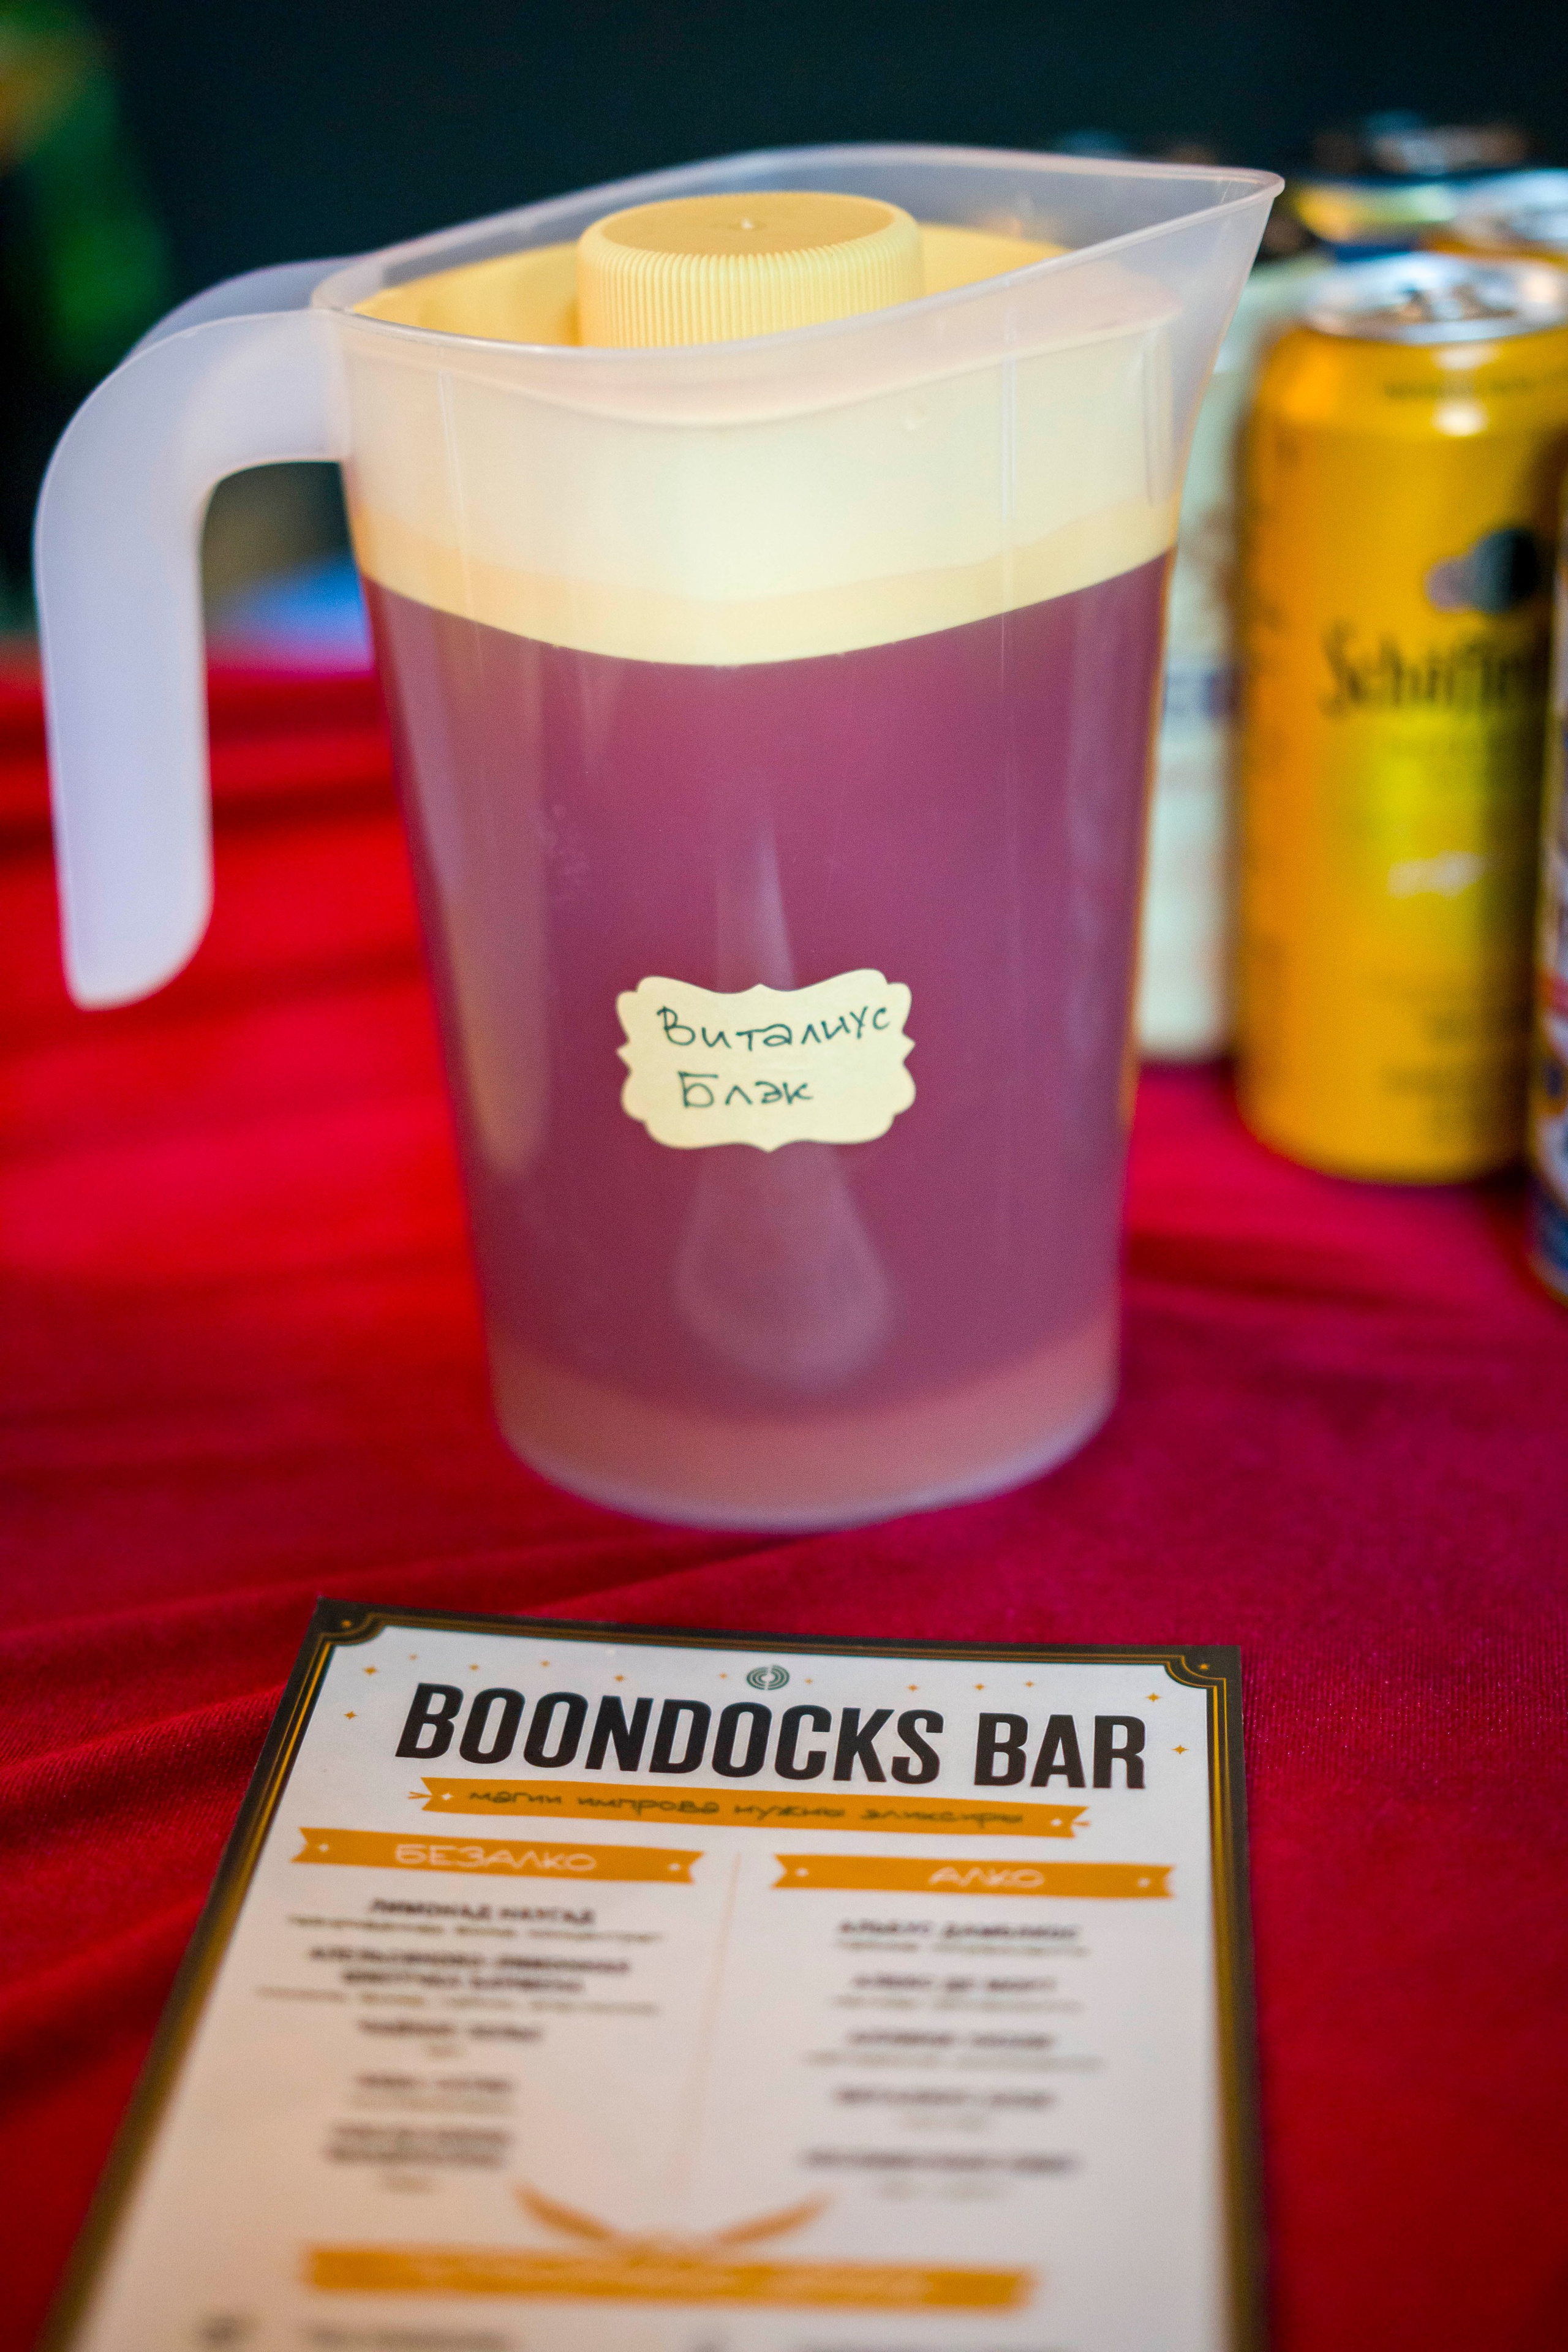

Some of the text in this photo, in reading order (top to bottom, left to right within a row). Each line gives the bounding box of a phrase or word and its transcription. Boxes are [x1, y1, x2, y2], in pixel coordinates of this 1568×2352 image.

[656, 1005, 890, 1051] Виталиус
[677, 1071, 814, 1108] Блэк
[395, 1682, 1146, 1789] BOONDOCKS BAR
[469, 1790, 562, 1804] магии
[578, 1796, 720, 1816] импрова
[394, 1842, 597, 1872] БЕЗАЛКО
[928, 1866, 1045, 1889] АЛКО
